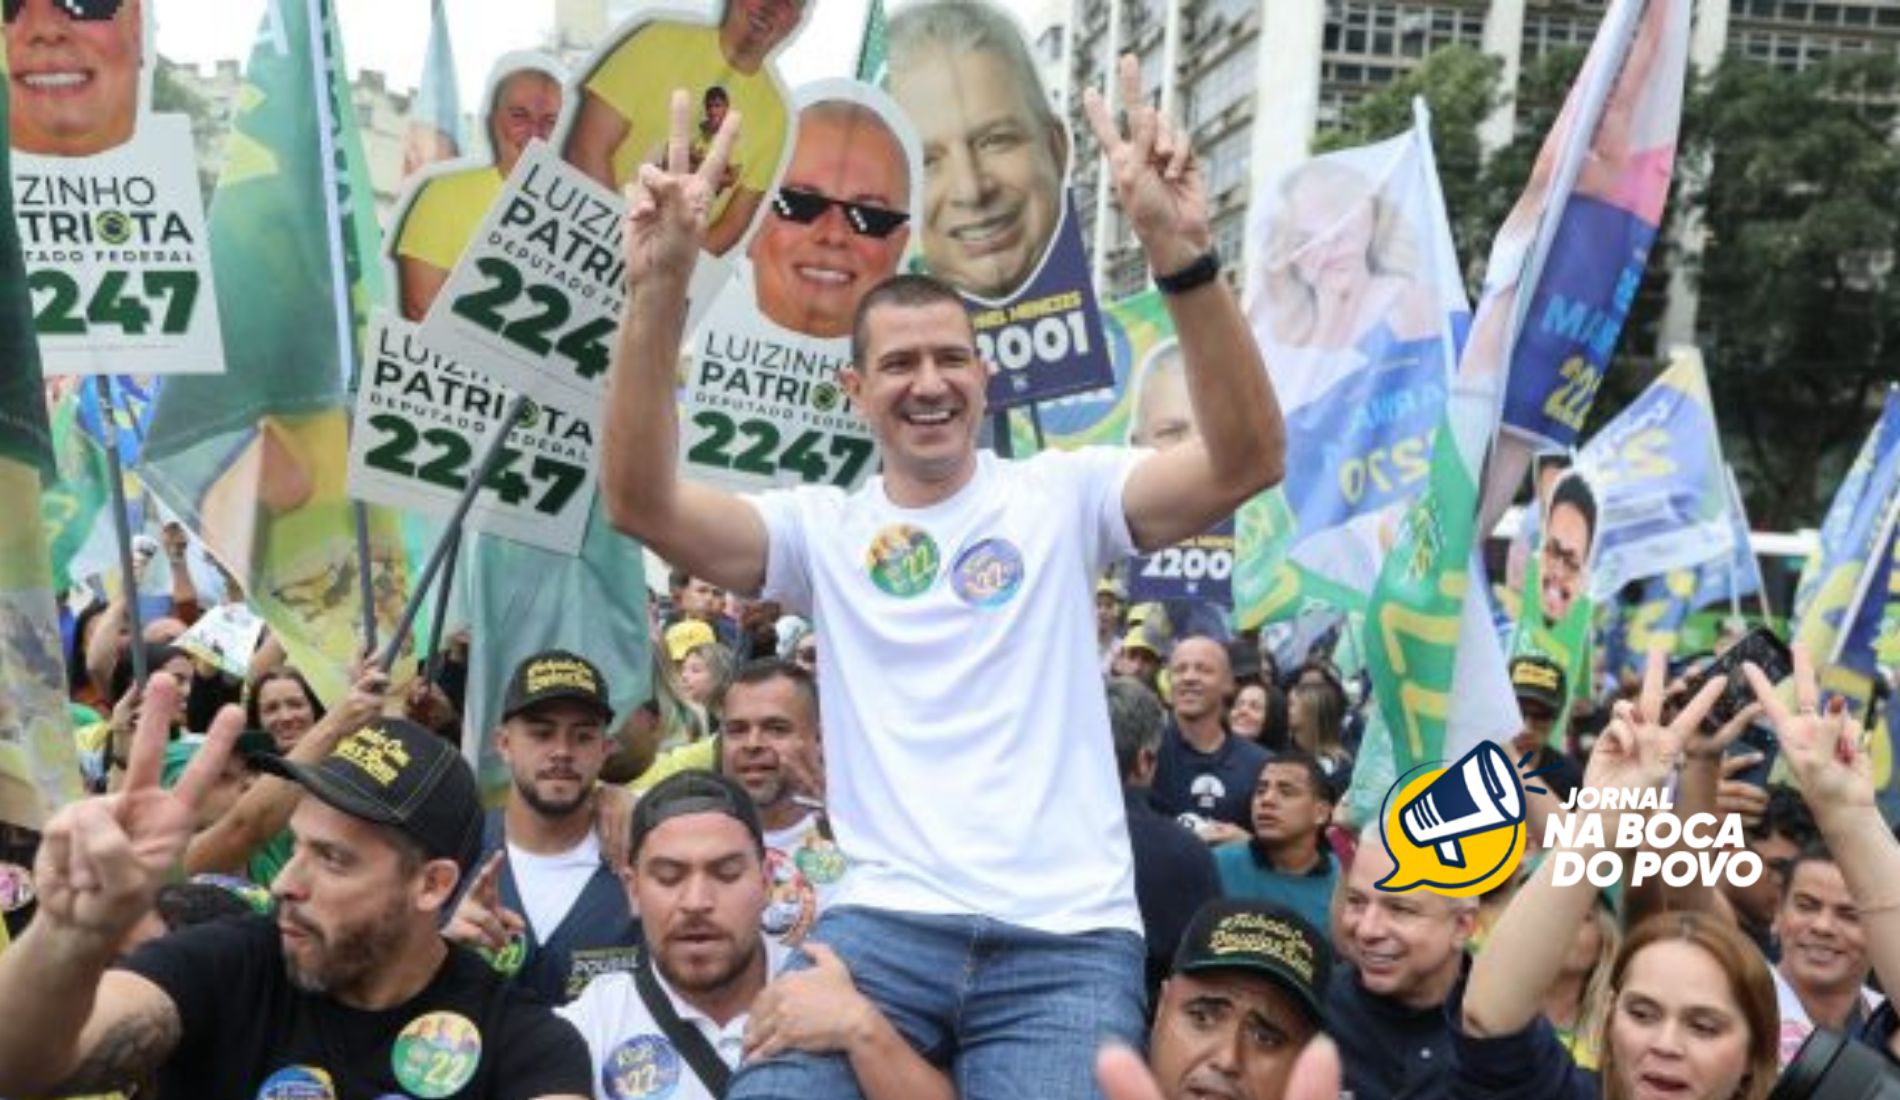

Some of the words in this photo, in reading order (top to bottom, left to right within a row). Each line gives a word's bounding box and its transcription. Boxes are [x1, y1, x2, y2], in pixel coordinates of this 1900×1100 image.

[15, 175, 156, 206] ZINHO
[520, 163, 624, 248] LUIZI
[18, 210, 194, 244] TRIOTA
[25, 250, 84, 263] TADO
[94, 250, 194, 263] FEDERAL
[501, 197, 626, 291] PATRI
[487, 230, 597, 299] DEPUTADO
[28, 268, 200, 335] 247
[451, 256, 619, 381] 224
[705, 331, 853, 378] LUIZINH
[370, 391, 487, 433] DEPUTADO
[696, 391, 794, 420] DEPUTADO
[364, 413, 587, 516] 2247
[687, 410, 875, 488] 2247
